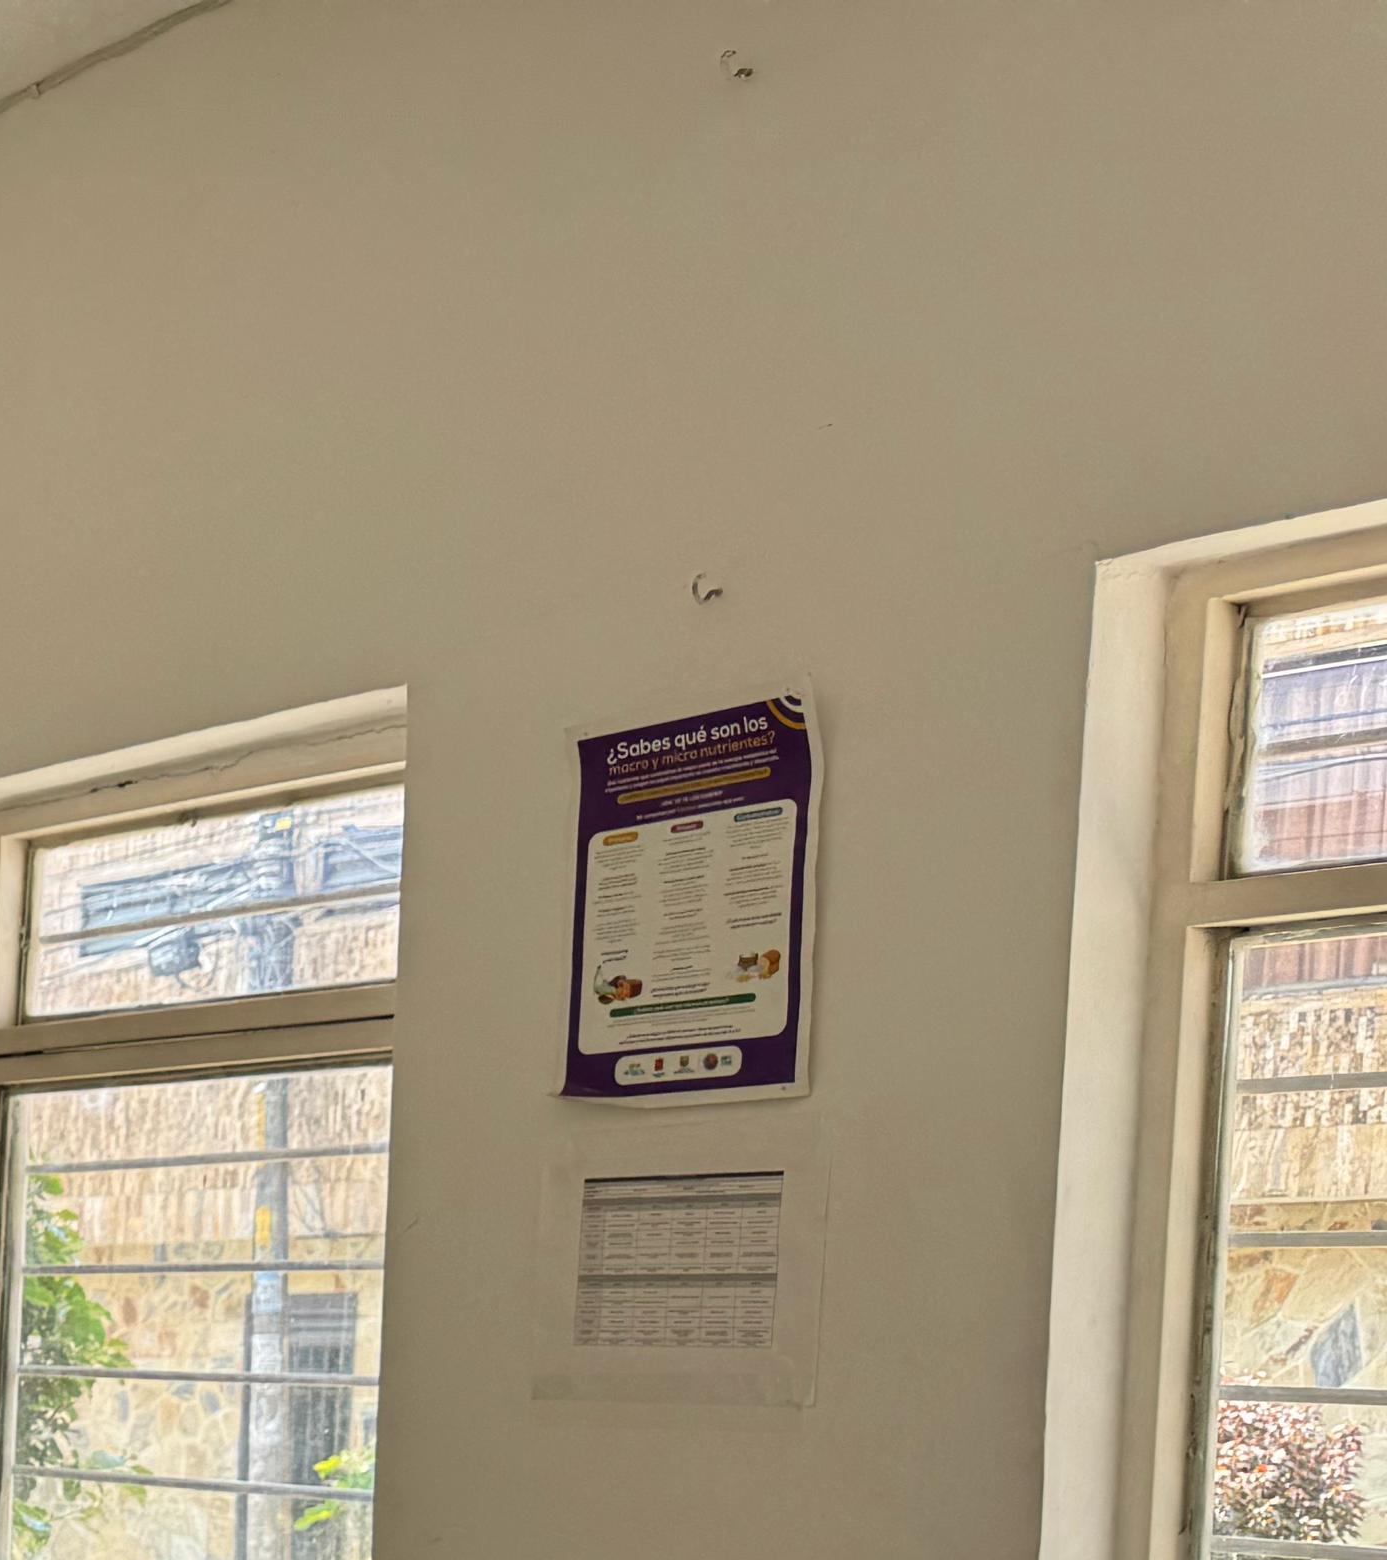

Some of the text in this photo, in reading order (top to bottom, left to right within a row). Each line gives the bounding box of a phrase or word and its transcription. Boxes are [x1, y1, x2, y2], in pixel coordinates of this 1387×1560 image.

[606, 715, 769, 765] ¿Sabes qué son los
[608, 758, 649, 776] macro
[652, 755, 660, 770] y
[661, 749, 697, 766] micro
[700, 730, 776, 757] nutrientes?
